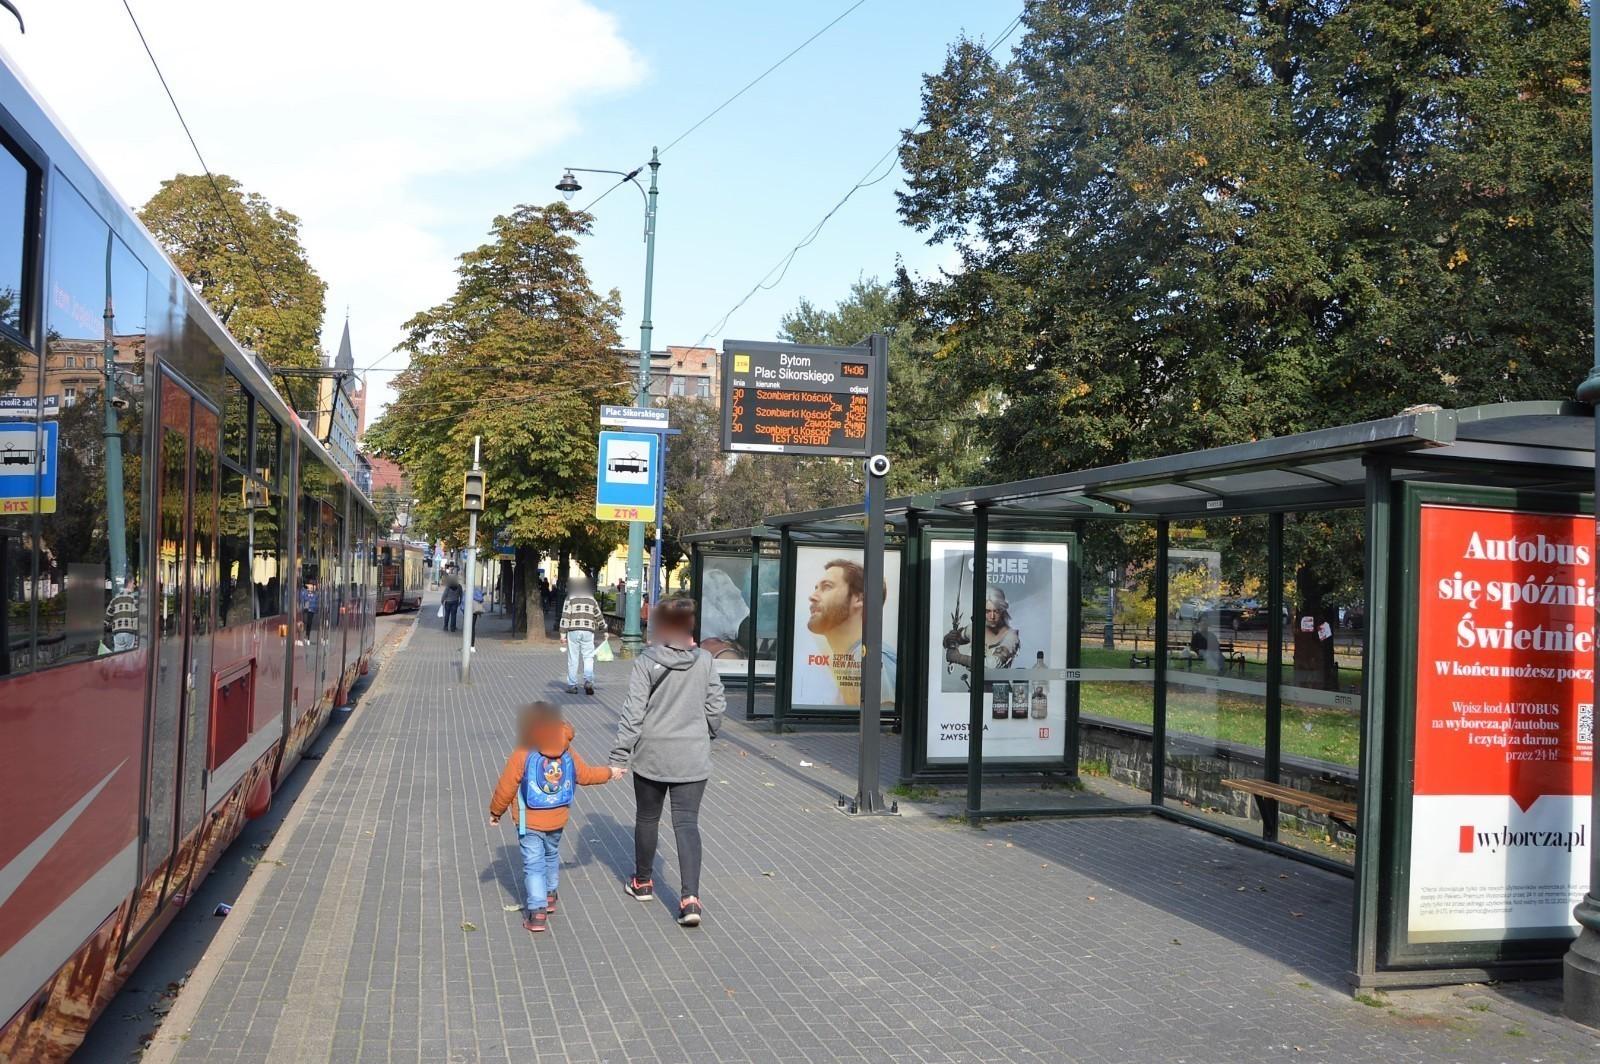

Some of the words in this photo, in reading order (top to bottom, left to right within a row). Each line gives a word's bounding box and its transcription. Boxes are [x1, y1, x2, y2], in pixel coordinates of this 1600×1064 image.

[780, 353, 811, 368] Bytom
[754, 366, 777, 379] Plac
[778, 368, 835, 384] Sikorskiego
[755, 380, 781, 389] kierunek
[756, 390, 800, 401] Szombierki
[605, 407, 622, 416] Plac
[622, 408, 665, 420] Sikorskiego
[755, 407, 799, 418] Szombierki
[755, 424, 798, 435] Szombierki
[771, 434, 791, 444] TEST
[793, 435, 829, 445] SYSTEMU
[614, 507, 639, 519] ZTM
[1462, 531, 1590, 566] Autobus
[1438, 571, 1482, 609] się
[808, 654, 830, 666] FOX
[1435, 661, 1451, 676] W
[1453, 661, 1499, 677] końcu
[1502, 664, 1555, 679] możesz
[1452, 701, 1481, 716] Wpisz
[1484, 702, 1503, 714] kod
[1504, 703, 1559, 715] AUTOBUS
[1432, 719, 1444, 729] na
[1445, 717, 1560, 731] wyborcza.pl/autobus
[940, 733, 971, 741] ZMYSŁ
[1468, 733, 1473, 745] i
[1474, 733, 1508, 747] czytaj
[1508, 736, 1521, 745] za
[1522, 734, 1559, 745] darmo
[1505, 750, 1533, 763] przez
[1534, 750, 1547, 761] 24
[1477, 824, 1585, 854] wyborcza.pl
